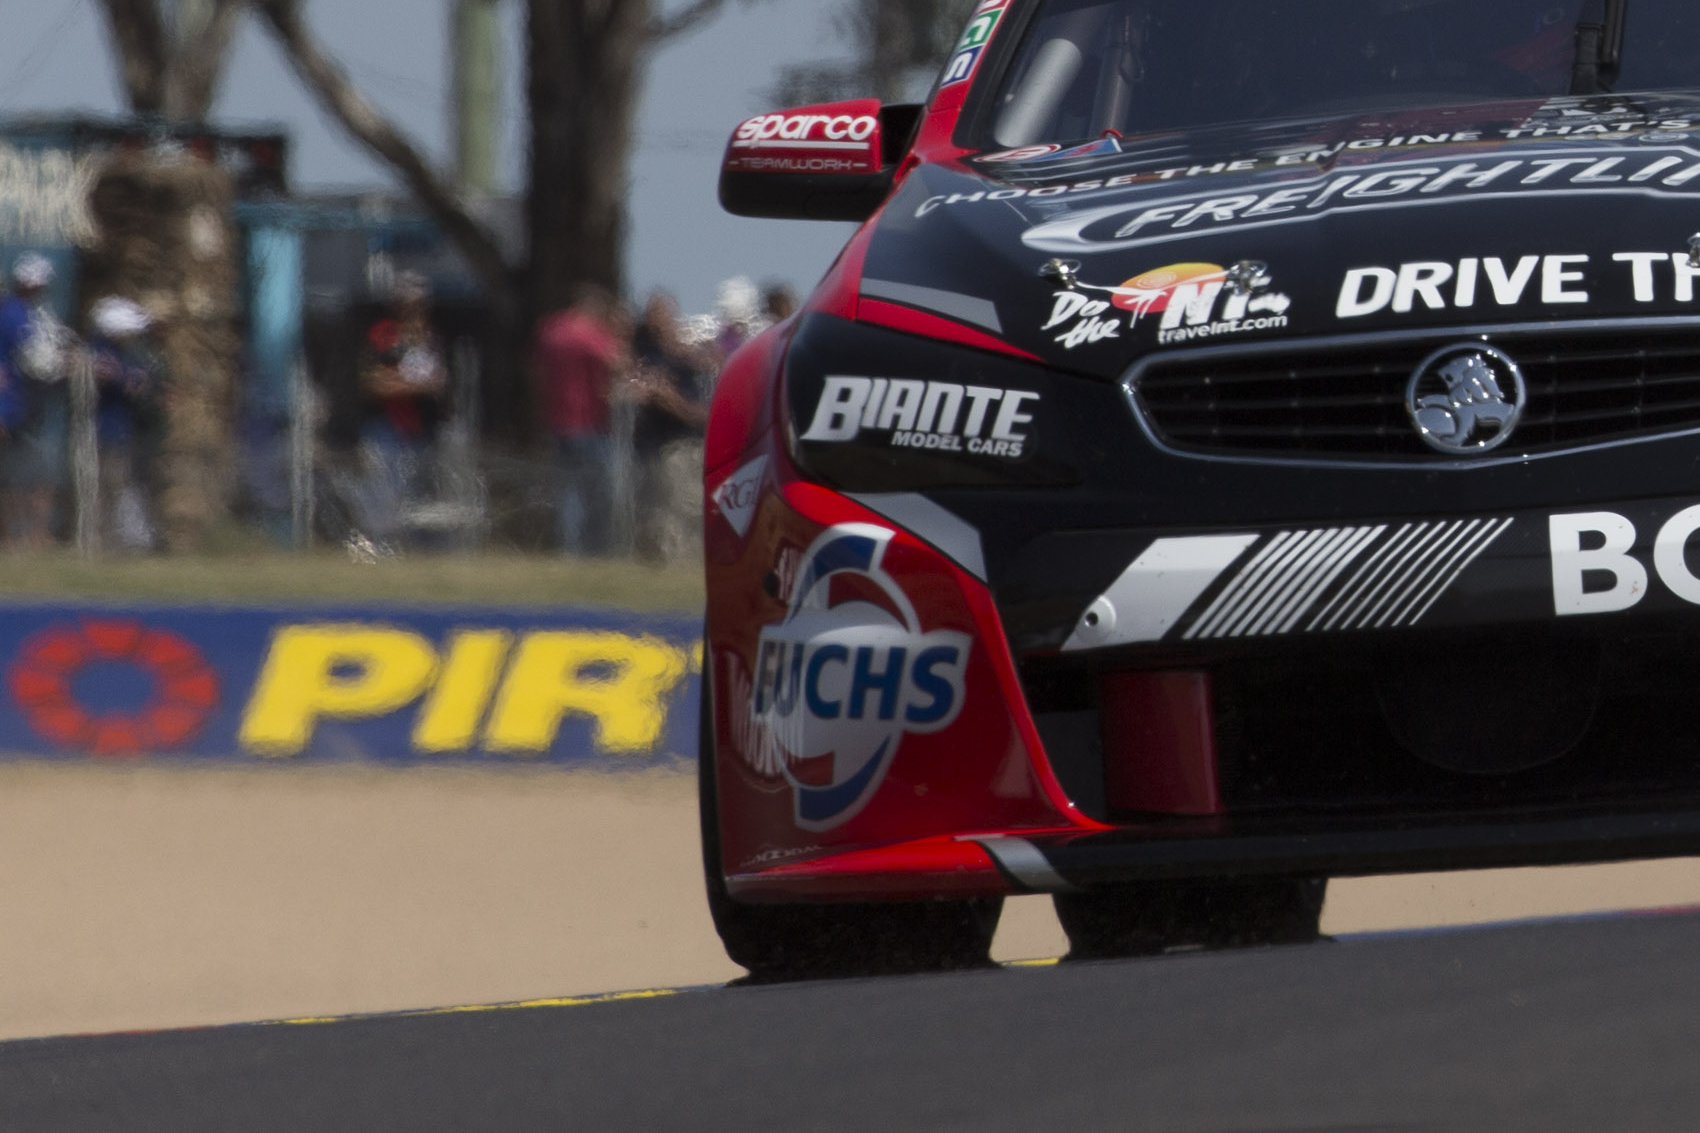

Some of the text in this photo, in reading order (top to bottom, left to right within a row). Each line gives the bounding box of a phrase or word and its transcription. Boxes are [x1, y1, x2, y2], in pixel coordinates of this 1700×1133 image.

[737, 115, 877, 149] sparco
[740, 156, 852, 170] TEAMWORK
[914, 173, 1137, 218] CHOOSE
[1149, 157, 1259, 180] THE
[1275, 130, 1484, 166] ENGINE
[1499, 118, 1692, 139] THAT'S
[1336, 254, 1590, 318] DRIVE
[1040, 290, 1111, 331] Do
[1158, 314, 1289, 345] travelnt.com
[1054, 316, 1121, 349] the
[799, 374, 1041, 442] BIANTE
[890, 430, 1024, 458] MODEL CARS
[239, 622, 704, 757] PIR
[752, 642, 961, 726] FUCHS
